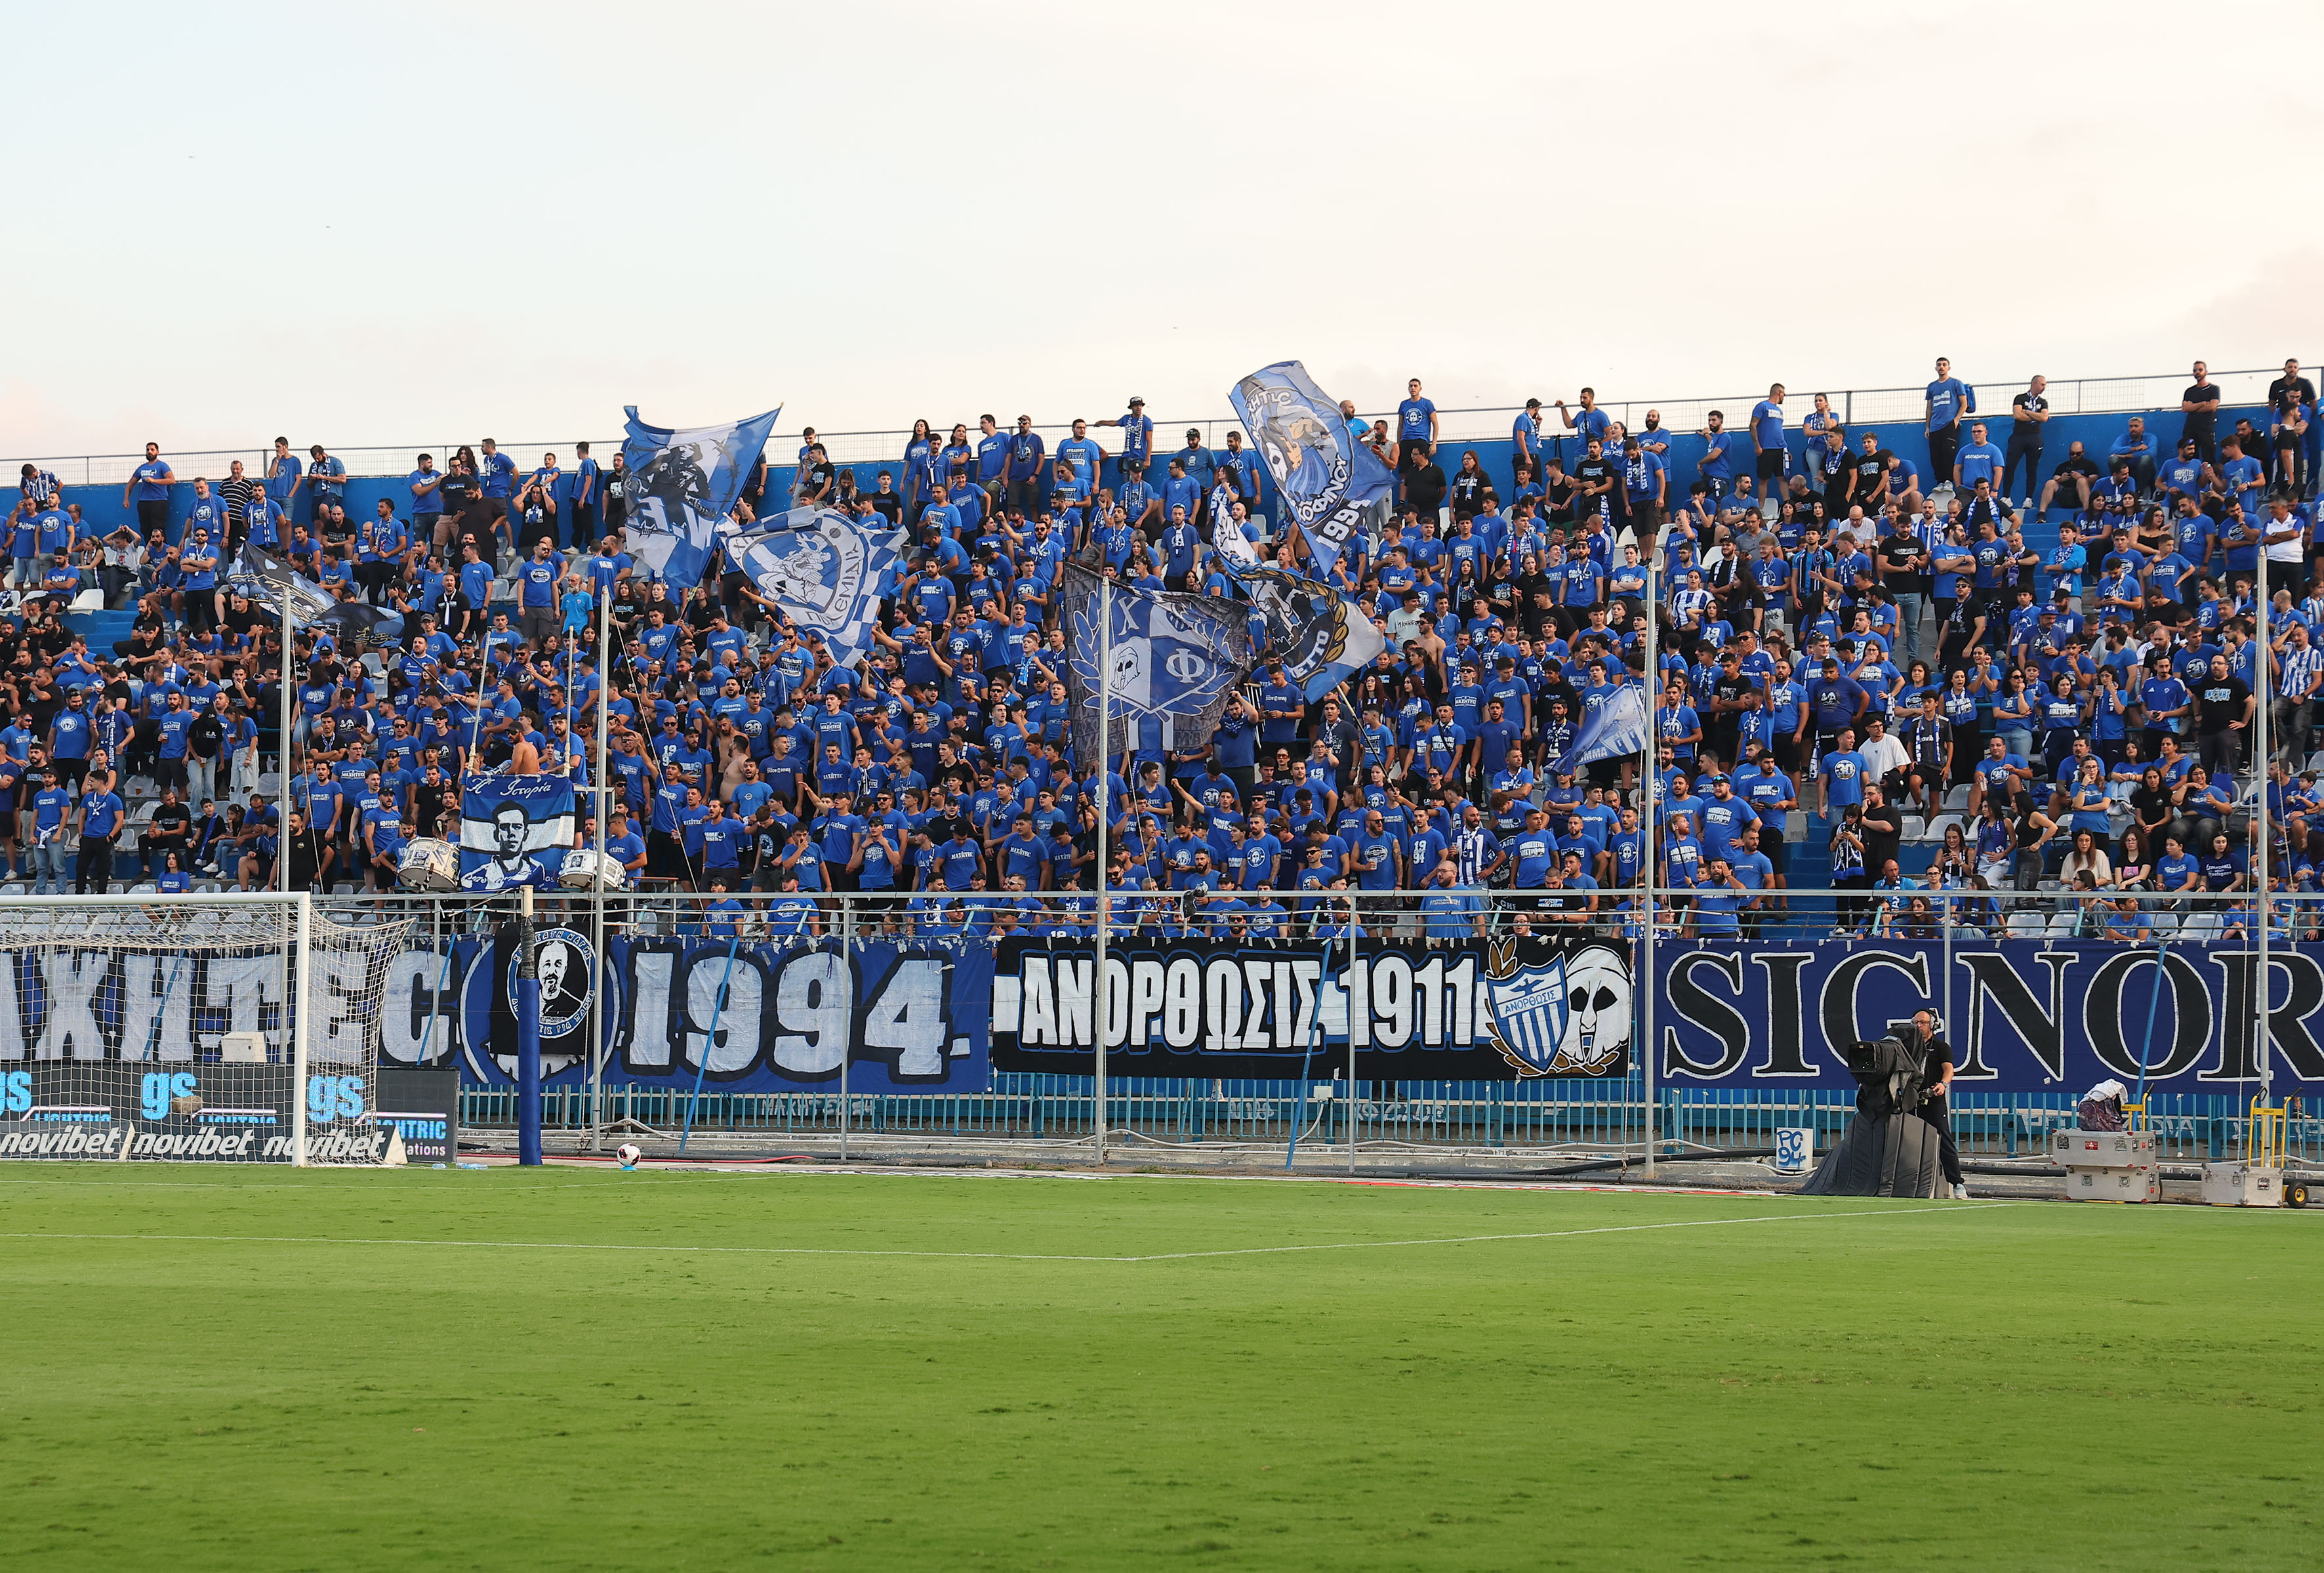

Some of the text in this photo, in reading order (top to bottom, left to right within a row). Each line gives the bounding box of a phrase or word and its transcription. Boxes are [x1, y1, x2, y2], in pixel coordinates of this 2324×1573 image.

[197, 508, 211, 518] 30
[45, 518, 57, 527] 30
[1315, 499, 1372, 552] 1994
[1980, 552, 1996, 560] 30
[1166, 648, 1206, 684] Φ
[663, 745, 677, 753] 19
[1837, 764, 1853, 774] 30
[1206, 791, 1219, 800] 30
[1010, 847, 1031, 857] ΜΑΧΗΤΕC
[1414, 840, 1426, 849] 19
[951, 851, 973, 860] ΜΑΧΗΤΕC
[1412, 853, 1424, 865] 94
[1021, 956, 1323, 1050] ΑΝΟΡΘΩΣΙΣ
[1339, 955, 1475, 1048] 1911
[1505, 990, 1557, 1015] ΑΝΟΡΘΩΣΙΣ
[556, 1021, 572, 1034] ΓΙΑ
[142, 1072, 196, 1120] gs
[308, 1074, 365, 1122] gs
[0, 1125, 121, 1154] novibet
[133, 1126, 254, 1156] novibet
[1777, 1130, 1803, 1152] PC
[1778, 1147, 1806, 1168] 94
